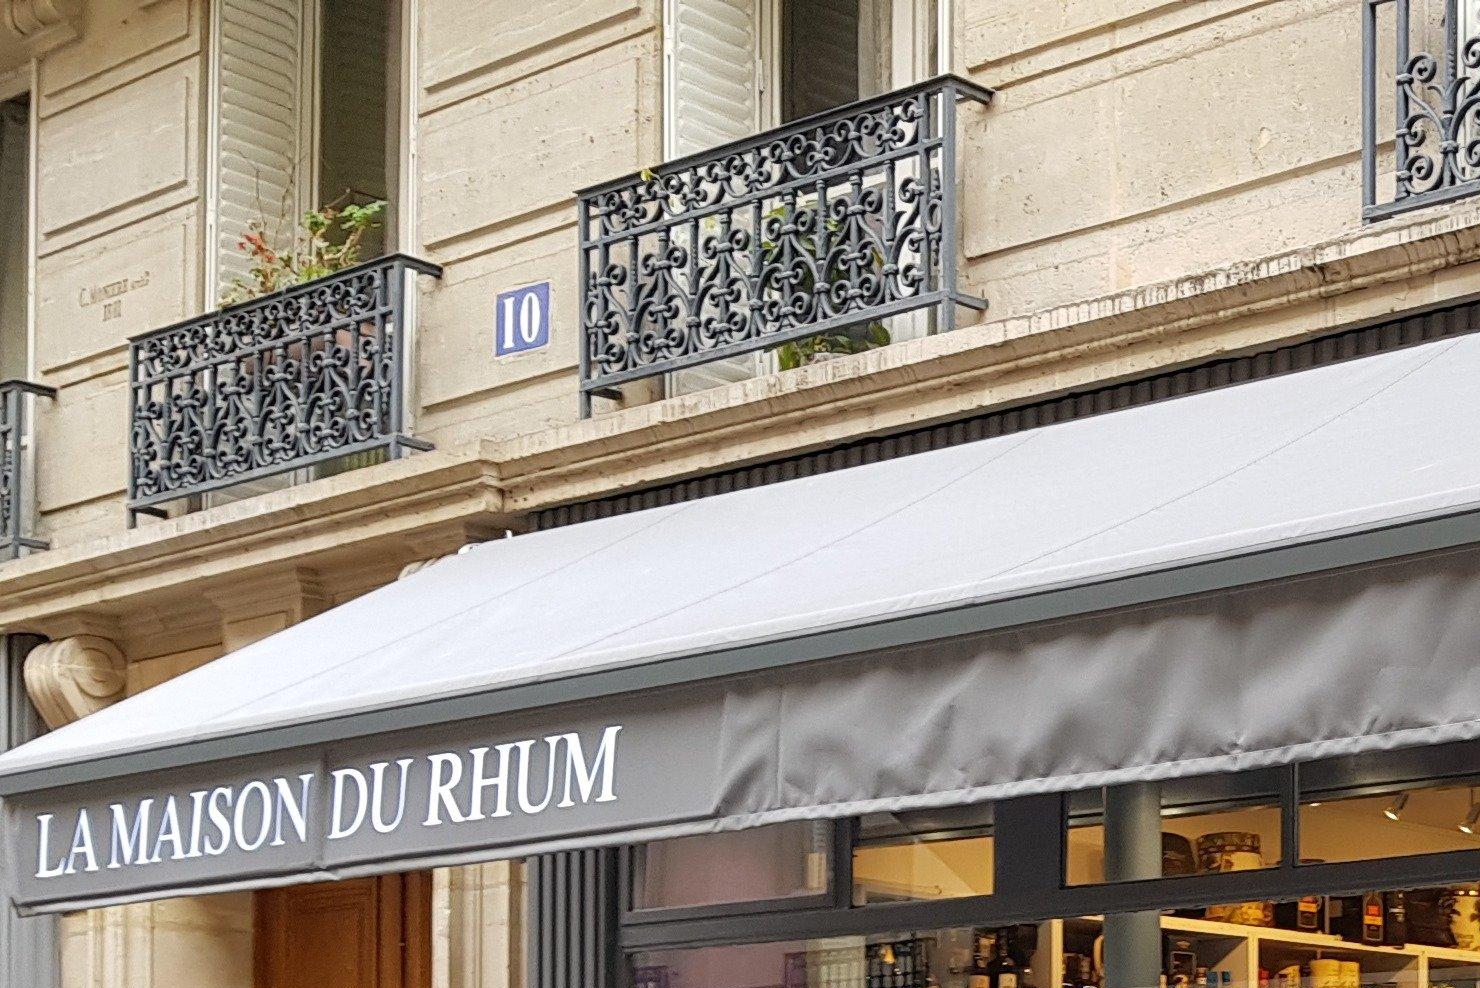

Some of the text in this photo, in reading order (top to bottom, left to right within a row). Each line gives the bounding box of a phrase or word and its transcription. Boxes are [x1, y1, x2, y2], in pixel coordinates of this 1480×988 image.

[503, 291, 541, 349] 10
[35, 725, 623, 878] LA MAISON DU RHUM
